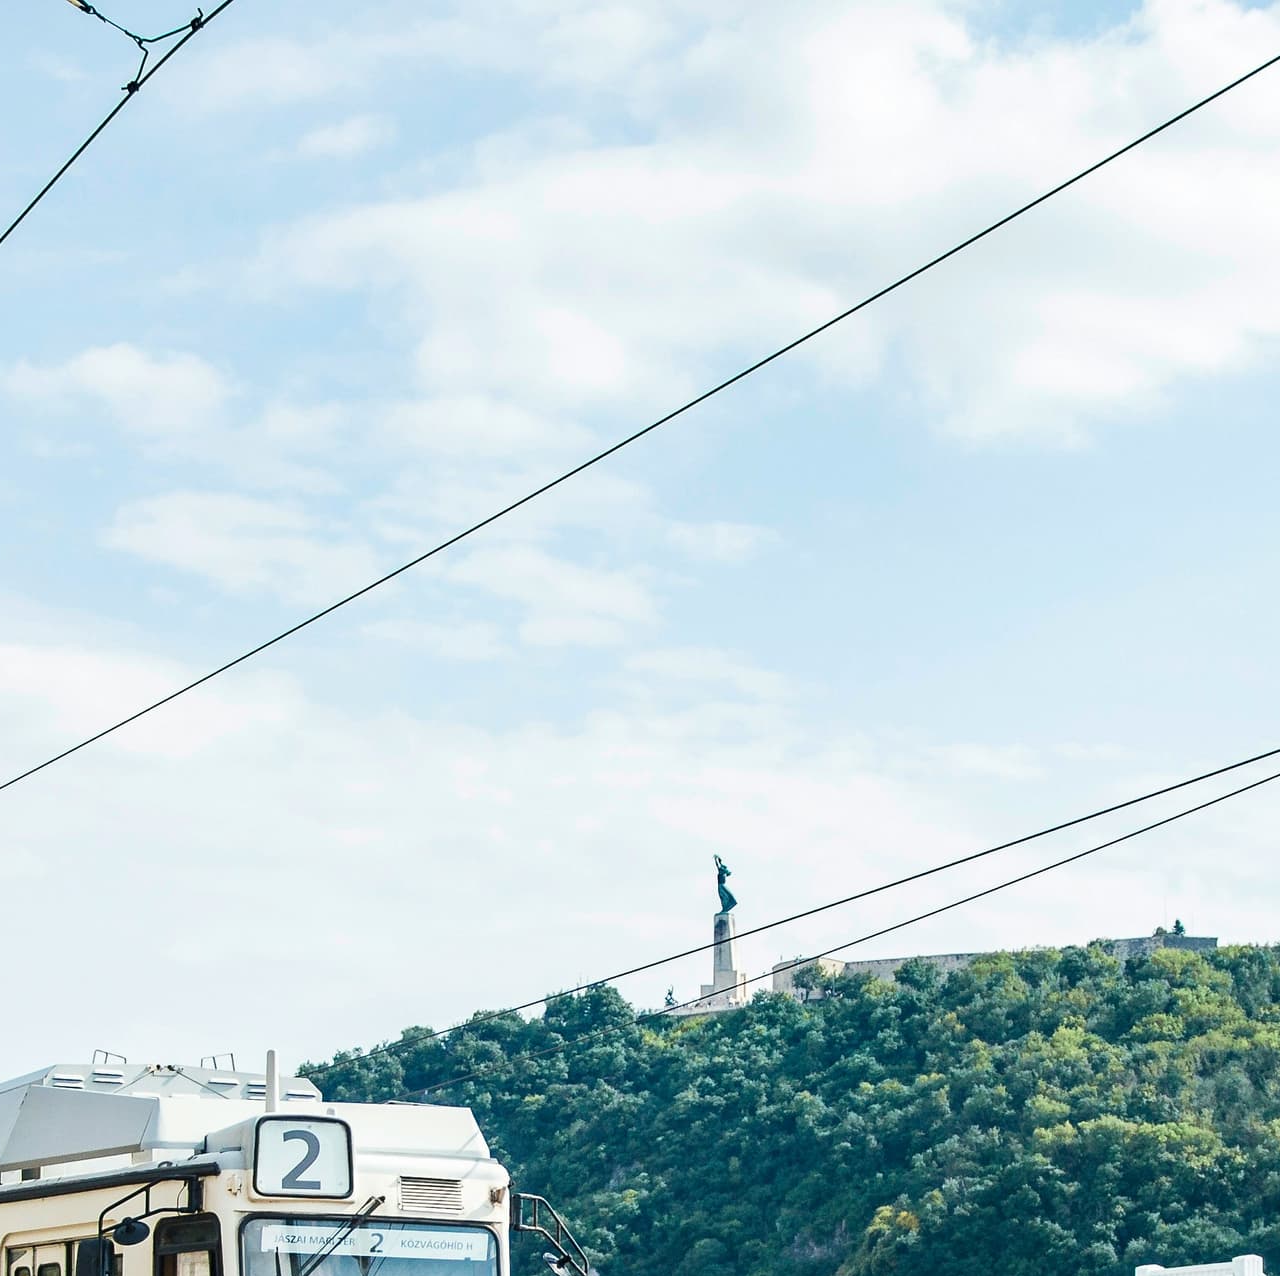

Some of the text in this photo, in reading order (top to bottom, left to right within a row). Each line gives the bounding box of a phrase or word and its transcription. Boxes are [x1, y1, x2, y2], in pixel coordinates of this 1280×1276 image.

[282, 1130, 321, 1190] 2
[369, 1232, 385, 1253] 2
[466, 1241, 473, 1251] H
